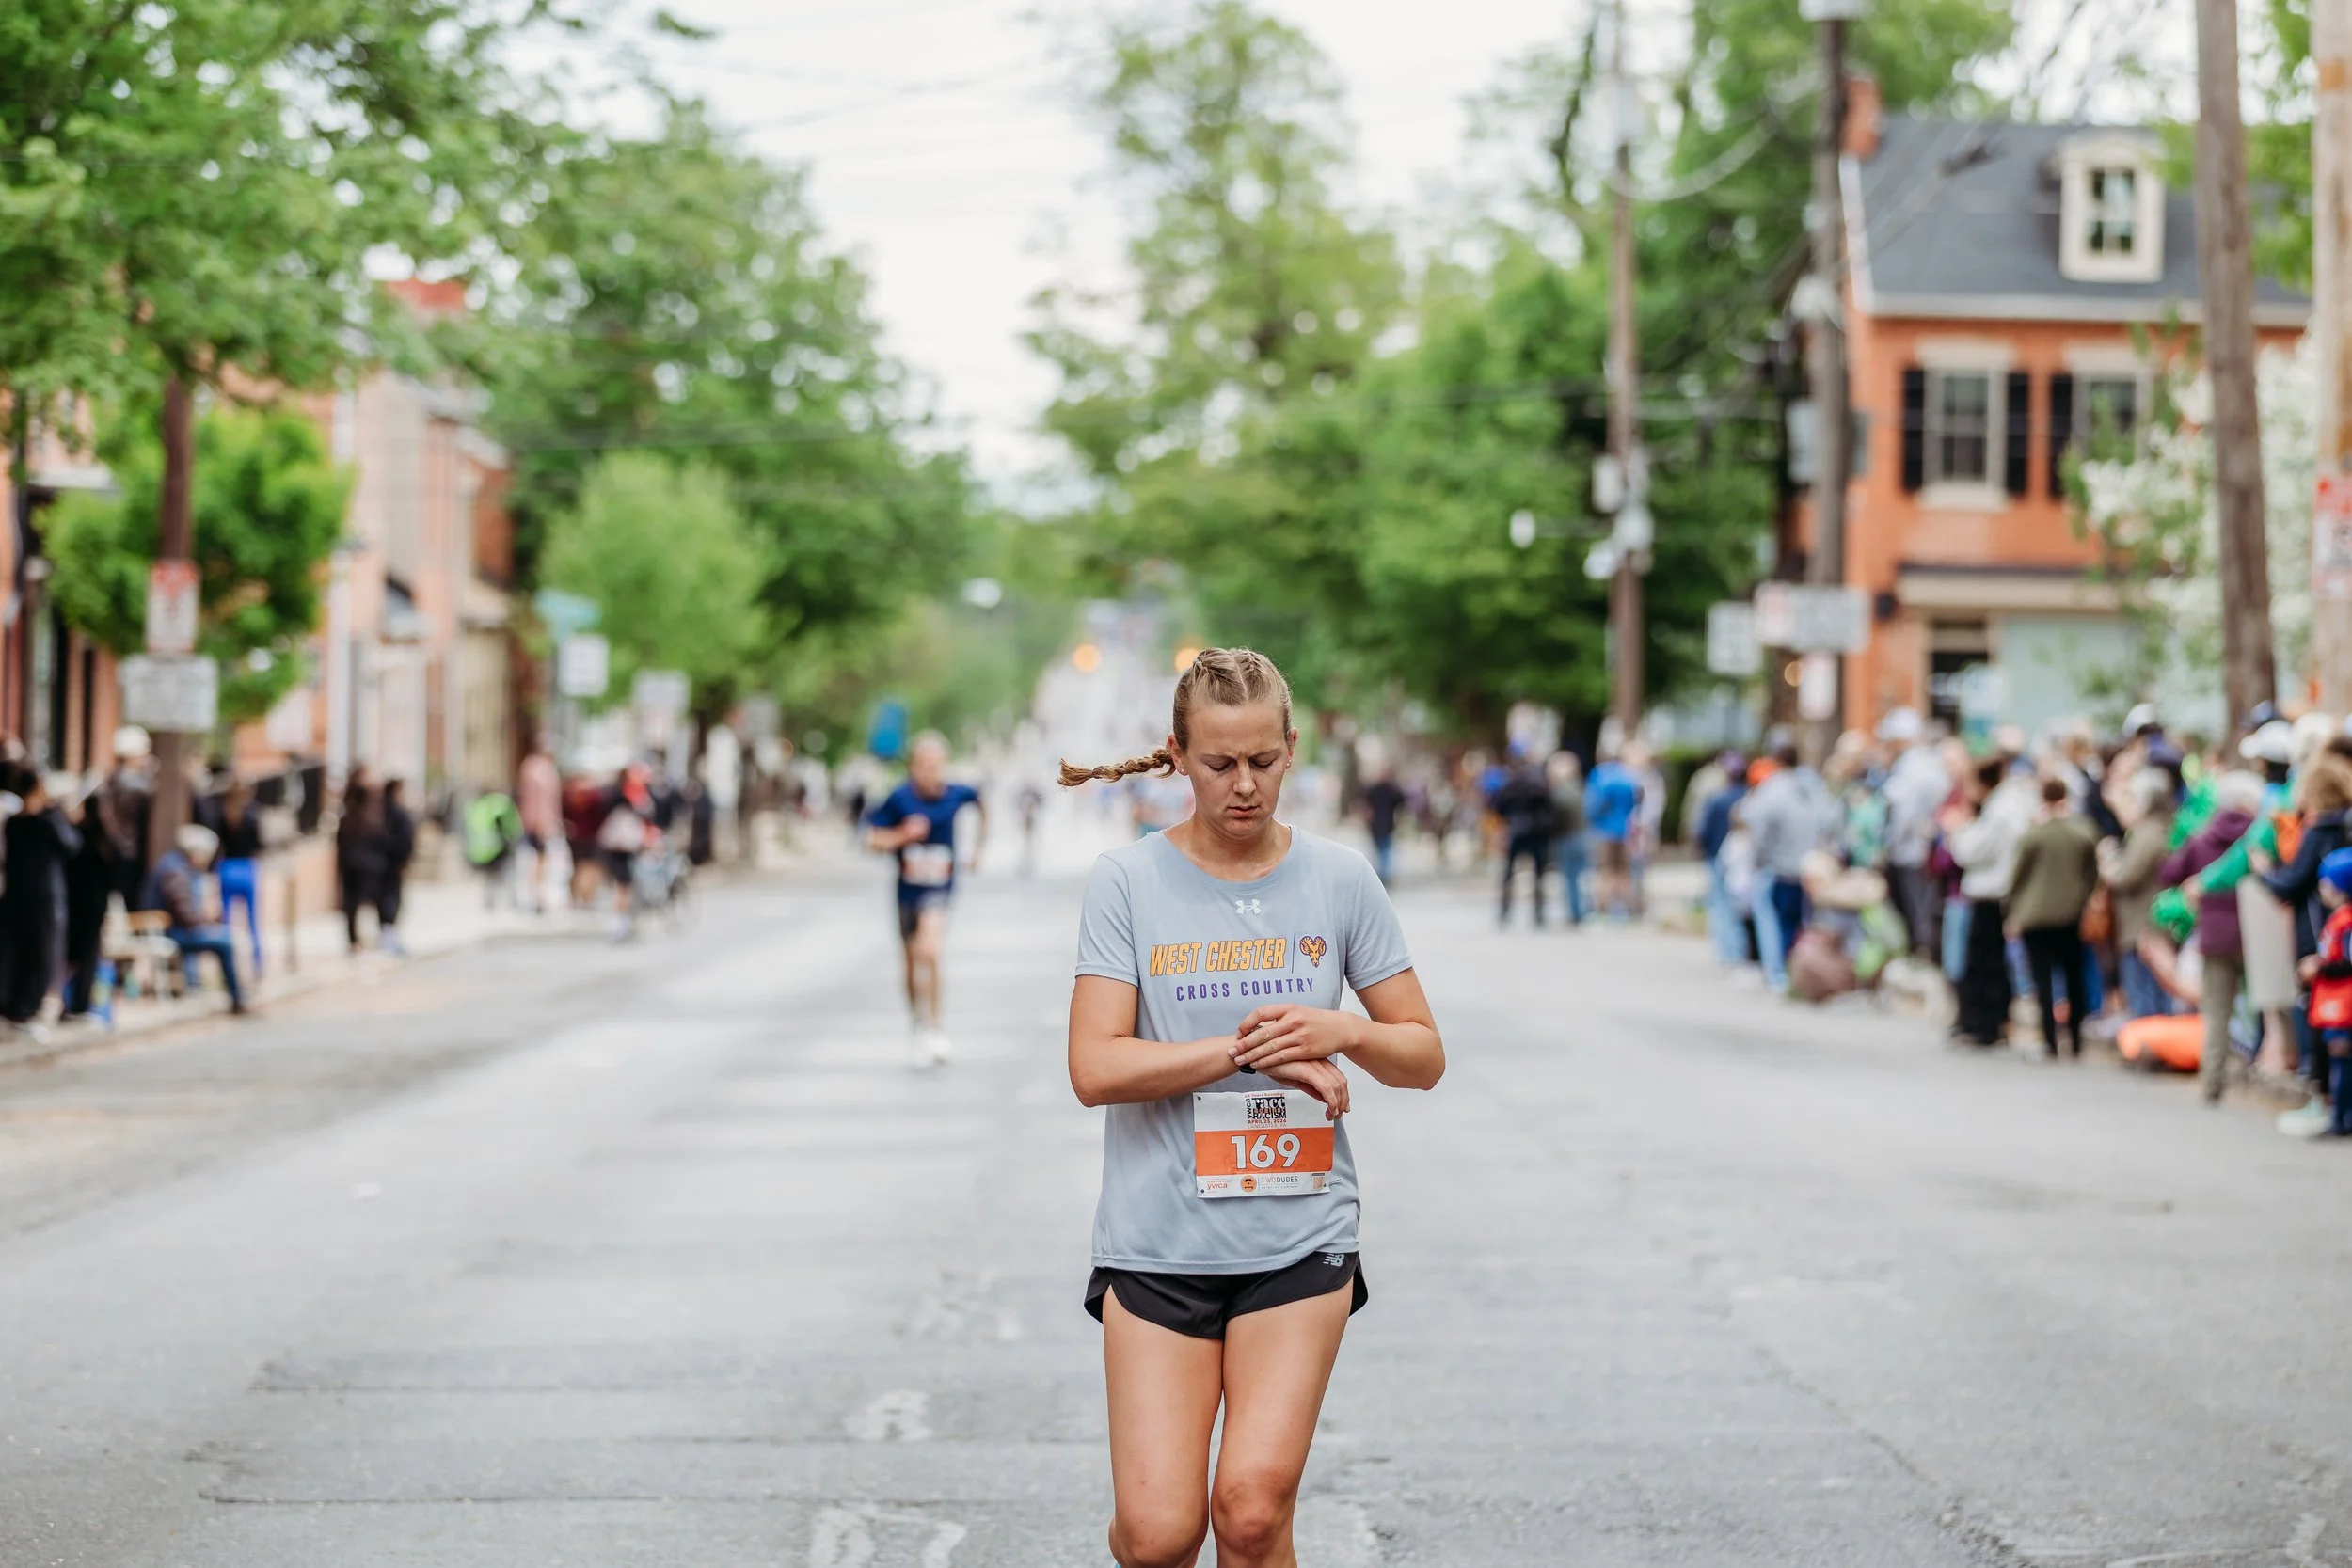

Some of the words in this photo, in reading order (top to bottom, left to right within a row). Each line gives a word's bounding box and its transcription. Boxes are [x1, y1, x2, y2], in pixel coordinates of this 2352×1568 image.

[1150, 942, 1202, 977] WEST
[1205, 938, 1286, 972] CHESTER
[1176, 983, 1230, 1002] CROSS
[1241, 978, 1313, 997] COUNTRY
[1251, 1097, 1286, 1108] race
[1231, 1133, 1301, 1169] 169
